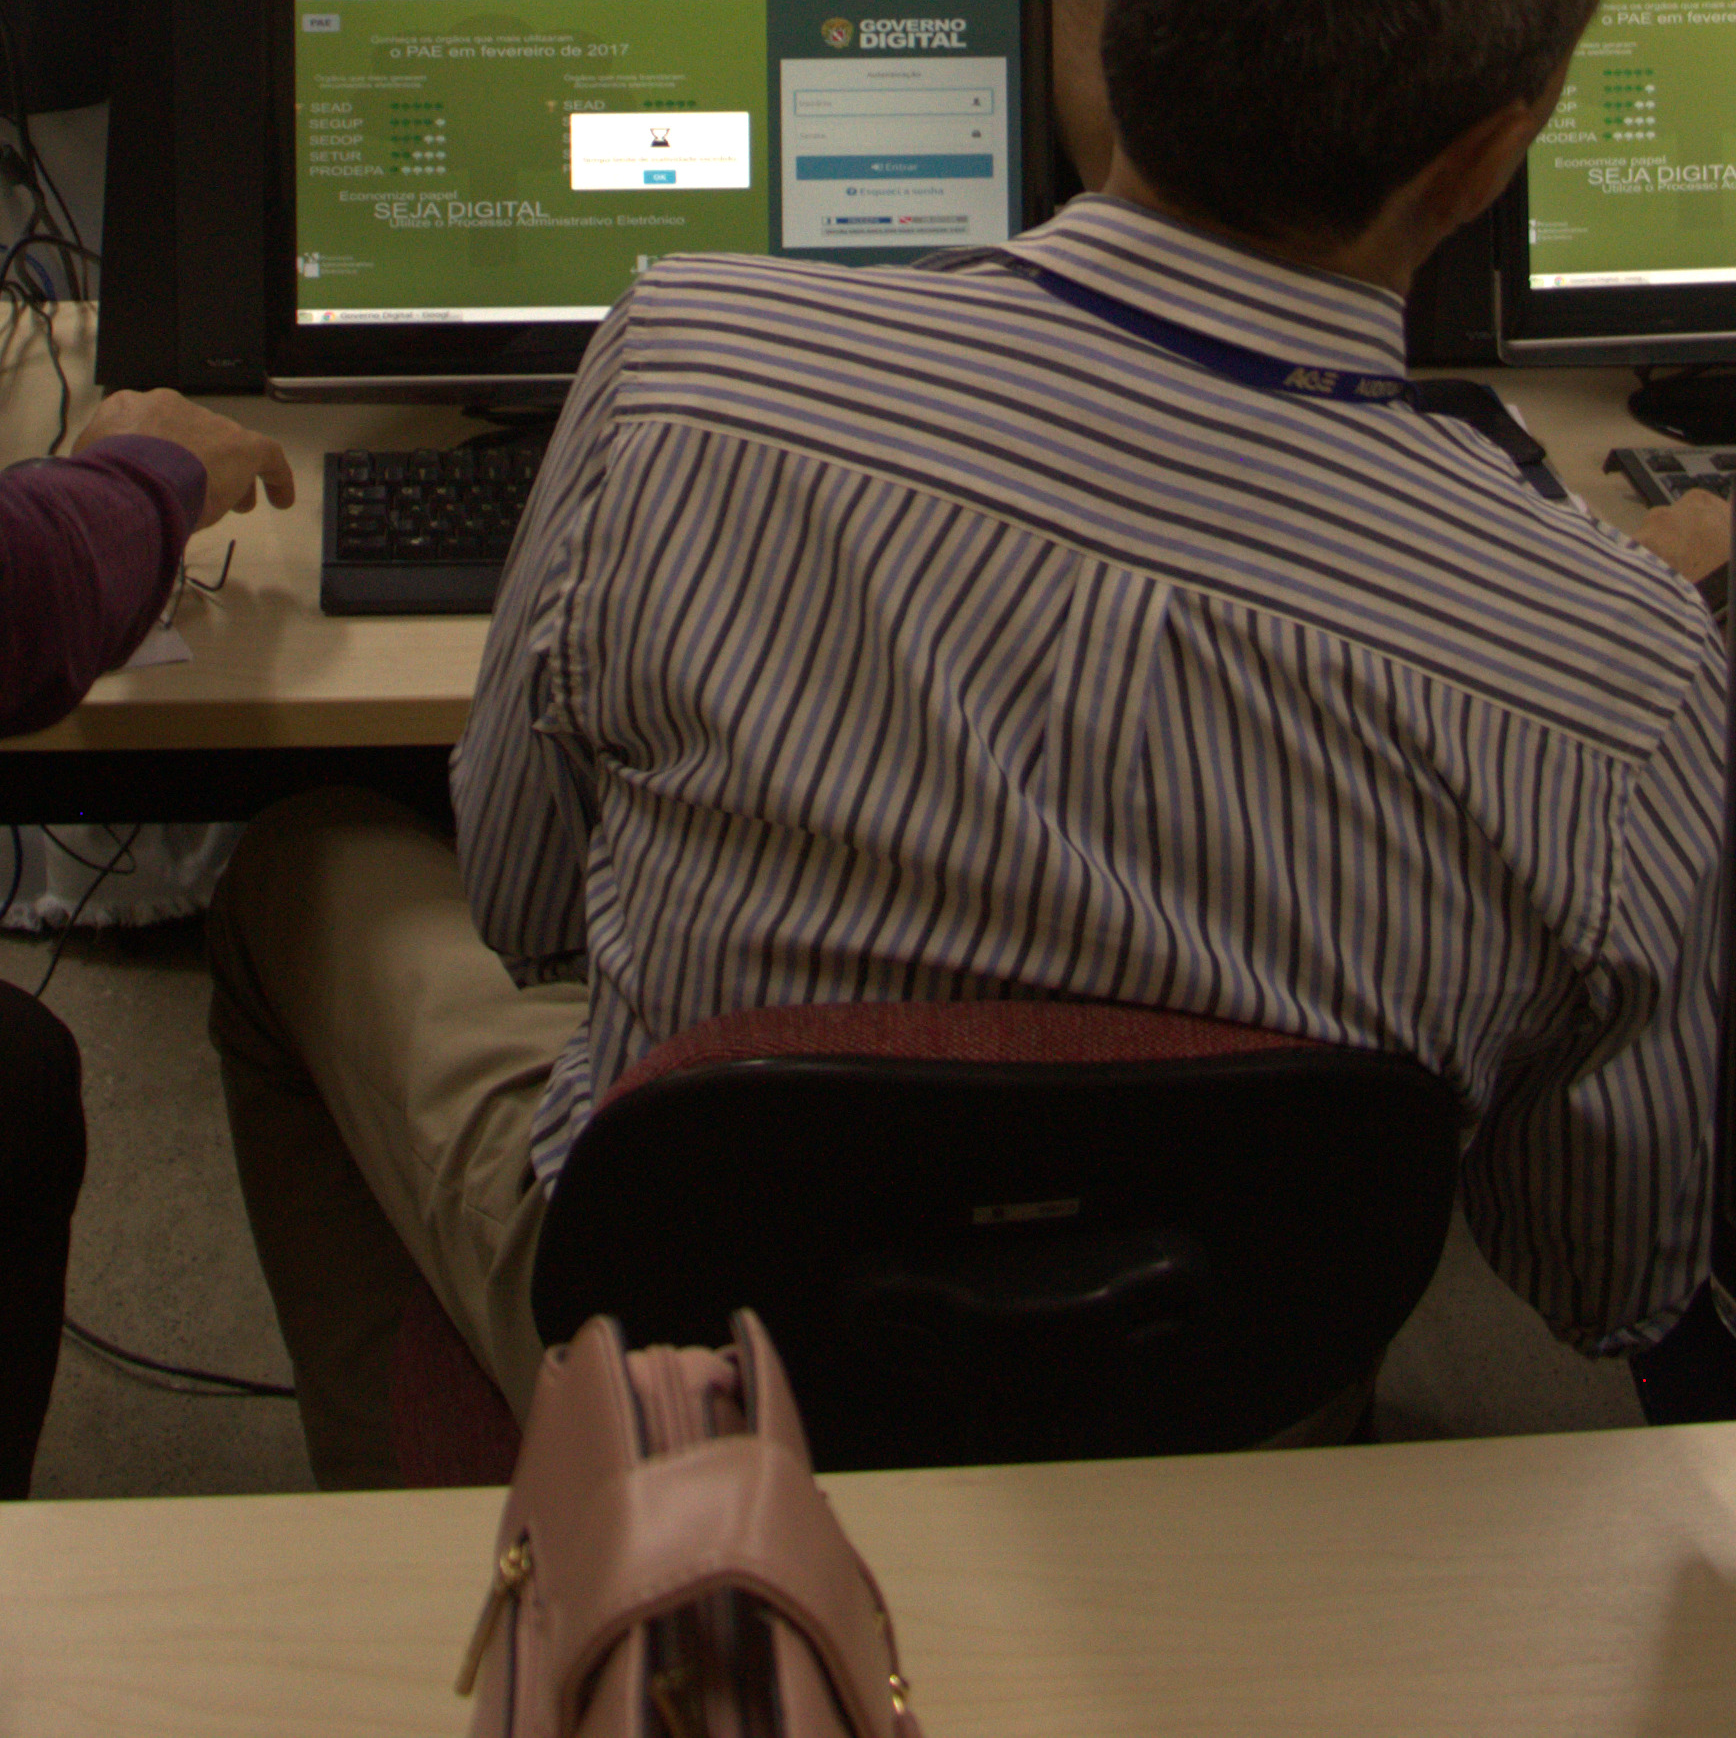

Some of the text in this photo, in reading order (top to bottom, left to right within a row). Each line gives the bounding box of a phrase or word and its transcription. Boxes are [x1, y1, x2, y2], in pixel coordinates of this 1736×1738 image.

[309, 18, 332, 27] PAE
[1601, 15, 1614, 27] o
[1617, 12, 1652, 25] PAE
[1657, 14, 1683, 25] em
[859, 18, 966, 33] GOVERNO
[474, 35, 493, 45] que
[859, 32, 967, 49] DIGITAL
[389, 43, 630, 58] o PAE em fevereiro de 2017
[311, 103, 352, 113] SEAD
[563, 100, 605, 111] SEAD
[309, 119, 363, 129] SEGUP
[309, 135, 363, 145] SEDOP
[1537, 132, 1597, 144] RODEPA
[309, 151, 362, 161] SETUR
[885, 162, 918, 171] Entrar
[1554, 155, 1667, 169] Economize papel
[309, 166, 384, 176] PRODEPA
[1588, 167, 1653, 186] SEJA
[860, 188, 901, 197] Esqueci
[1602, 182, 1642, 195] Utilize
[1645, 183, 1654, 192] o
[1658, 180, 1718, 192] Processo
[339, 190, 457, 202] Economize papel
[374, 200, 549, 219] SEJA DIGITAL
[389, 214, 685, 228] Utilize o Processo Administrativo Eletrônico
[340, 311, 381, 320] Governo
